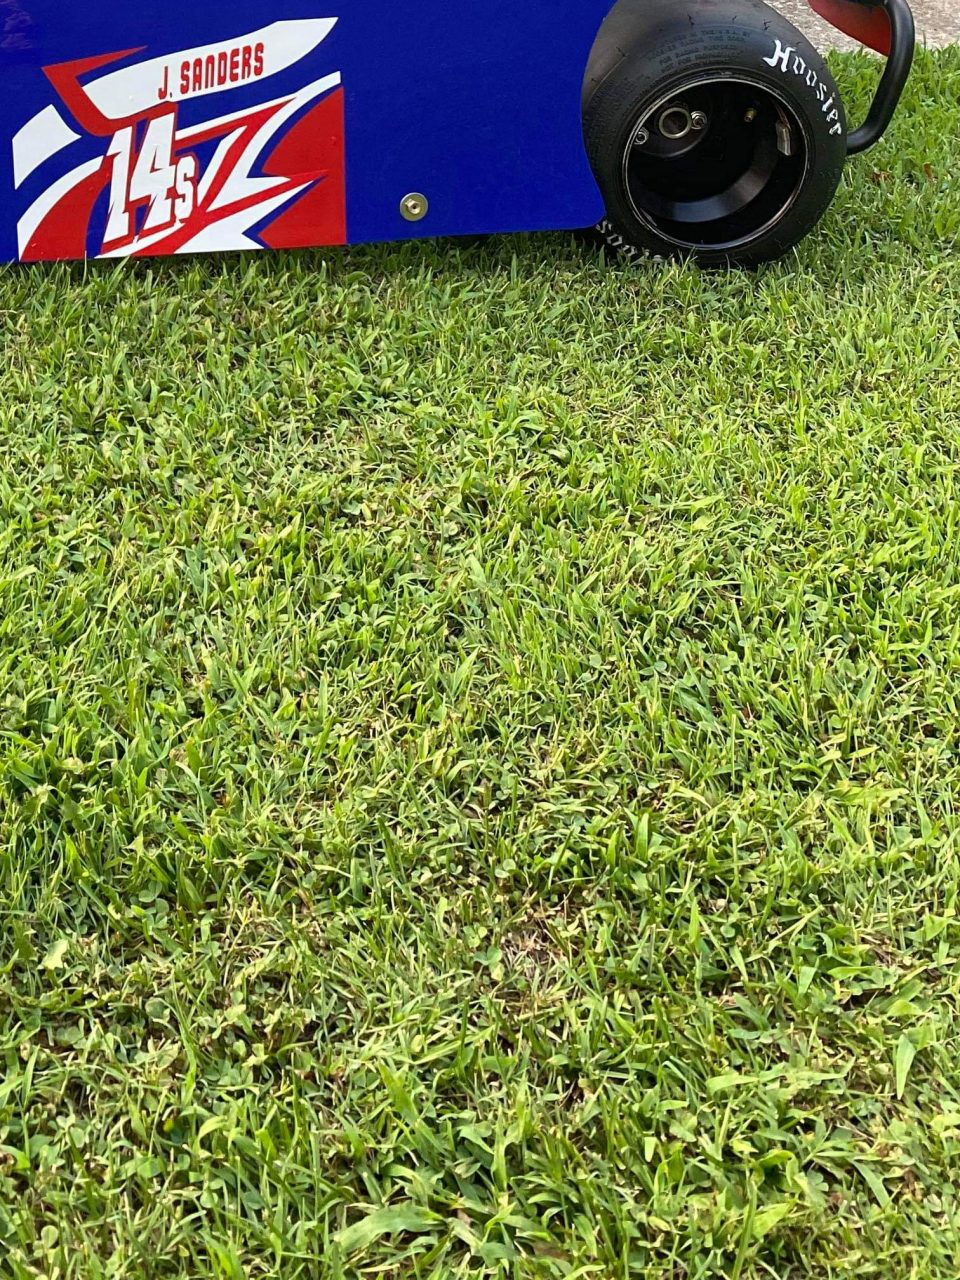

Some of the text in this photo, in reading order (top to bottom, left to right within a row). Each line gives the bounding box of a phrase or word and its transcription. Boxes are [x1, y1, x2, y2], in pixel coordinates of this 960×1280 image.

[158, 42, 265, 100] J. SANDERS
[762, 39, 842, 135] Hoosier
